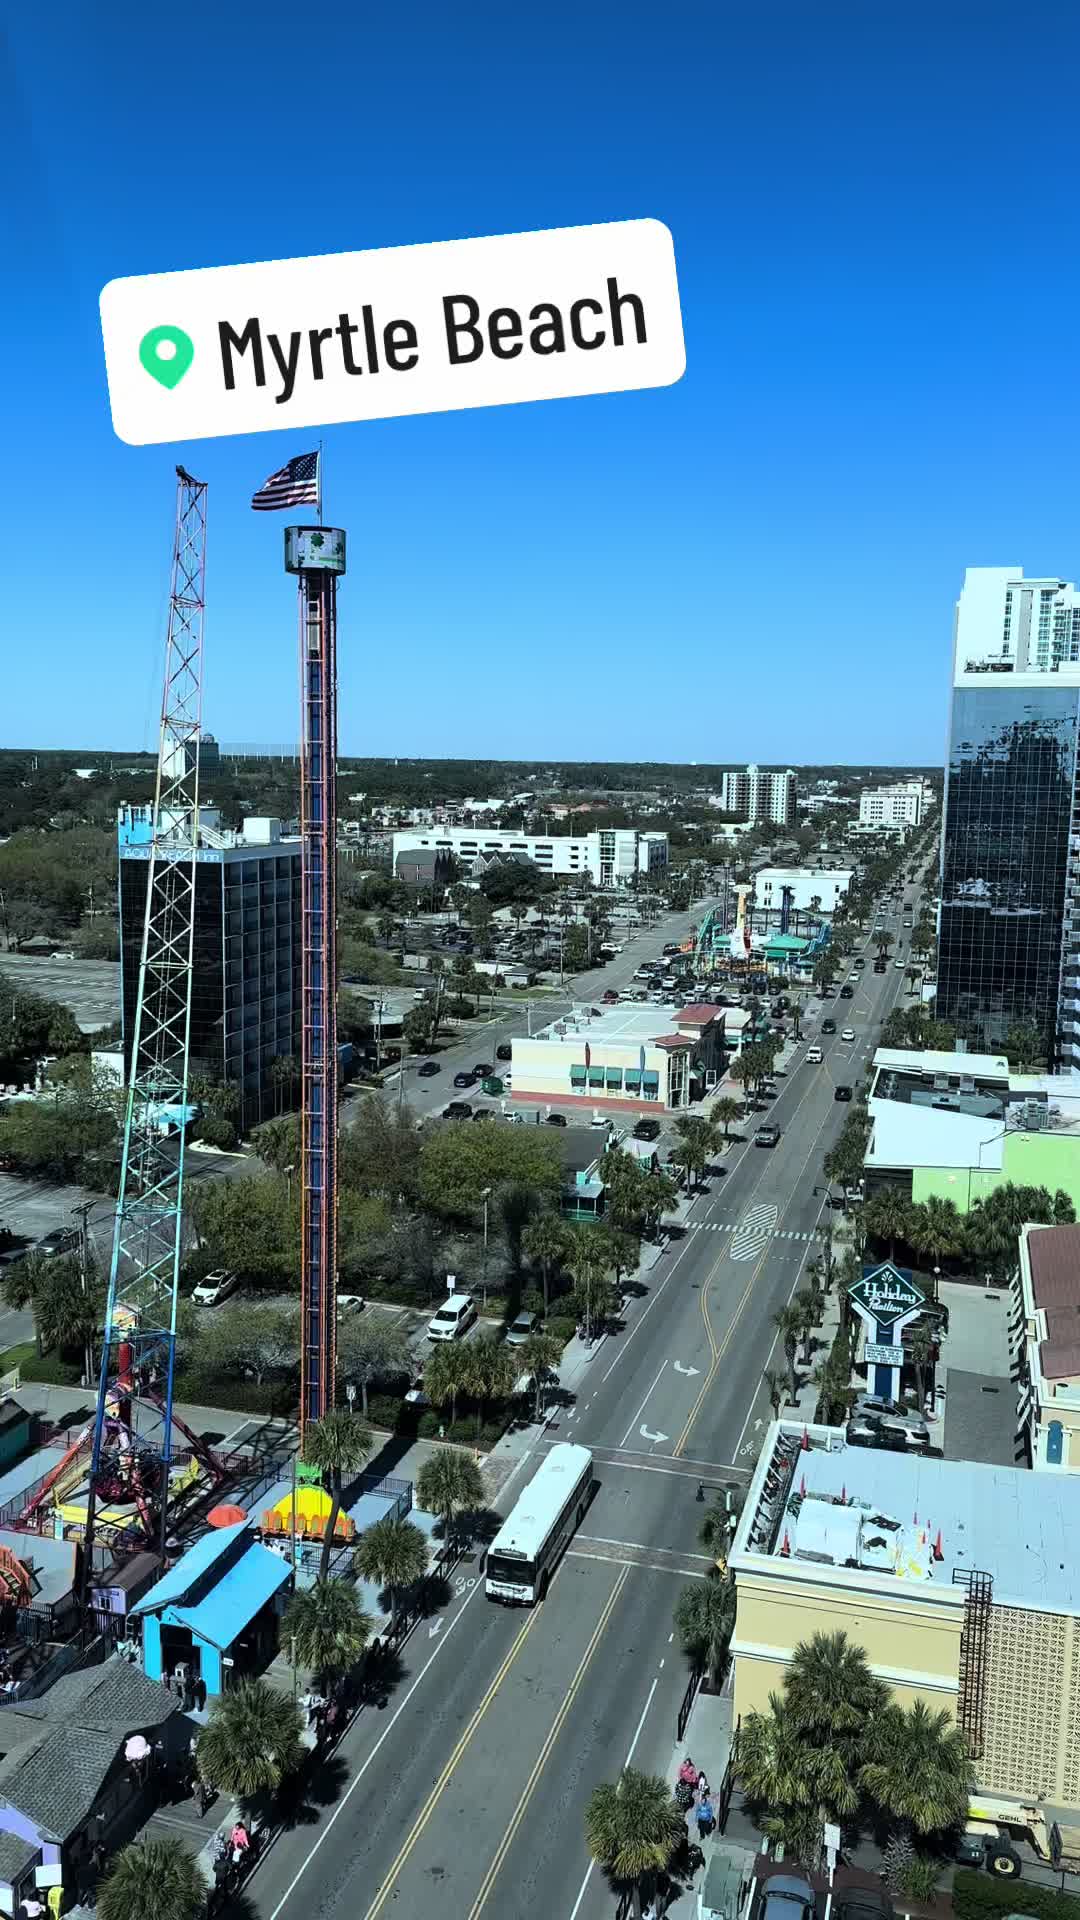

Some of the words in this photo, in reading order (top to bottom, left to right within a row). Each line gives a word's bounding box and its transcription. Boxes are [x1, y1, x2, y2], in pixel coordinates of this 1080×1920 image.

[864, 1282, 916, 1304] Holiday
[869, 1297, 904, 1312] Pavilion
[998, 1814, 1022, 1823] GEHL
